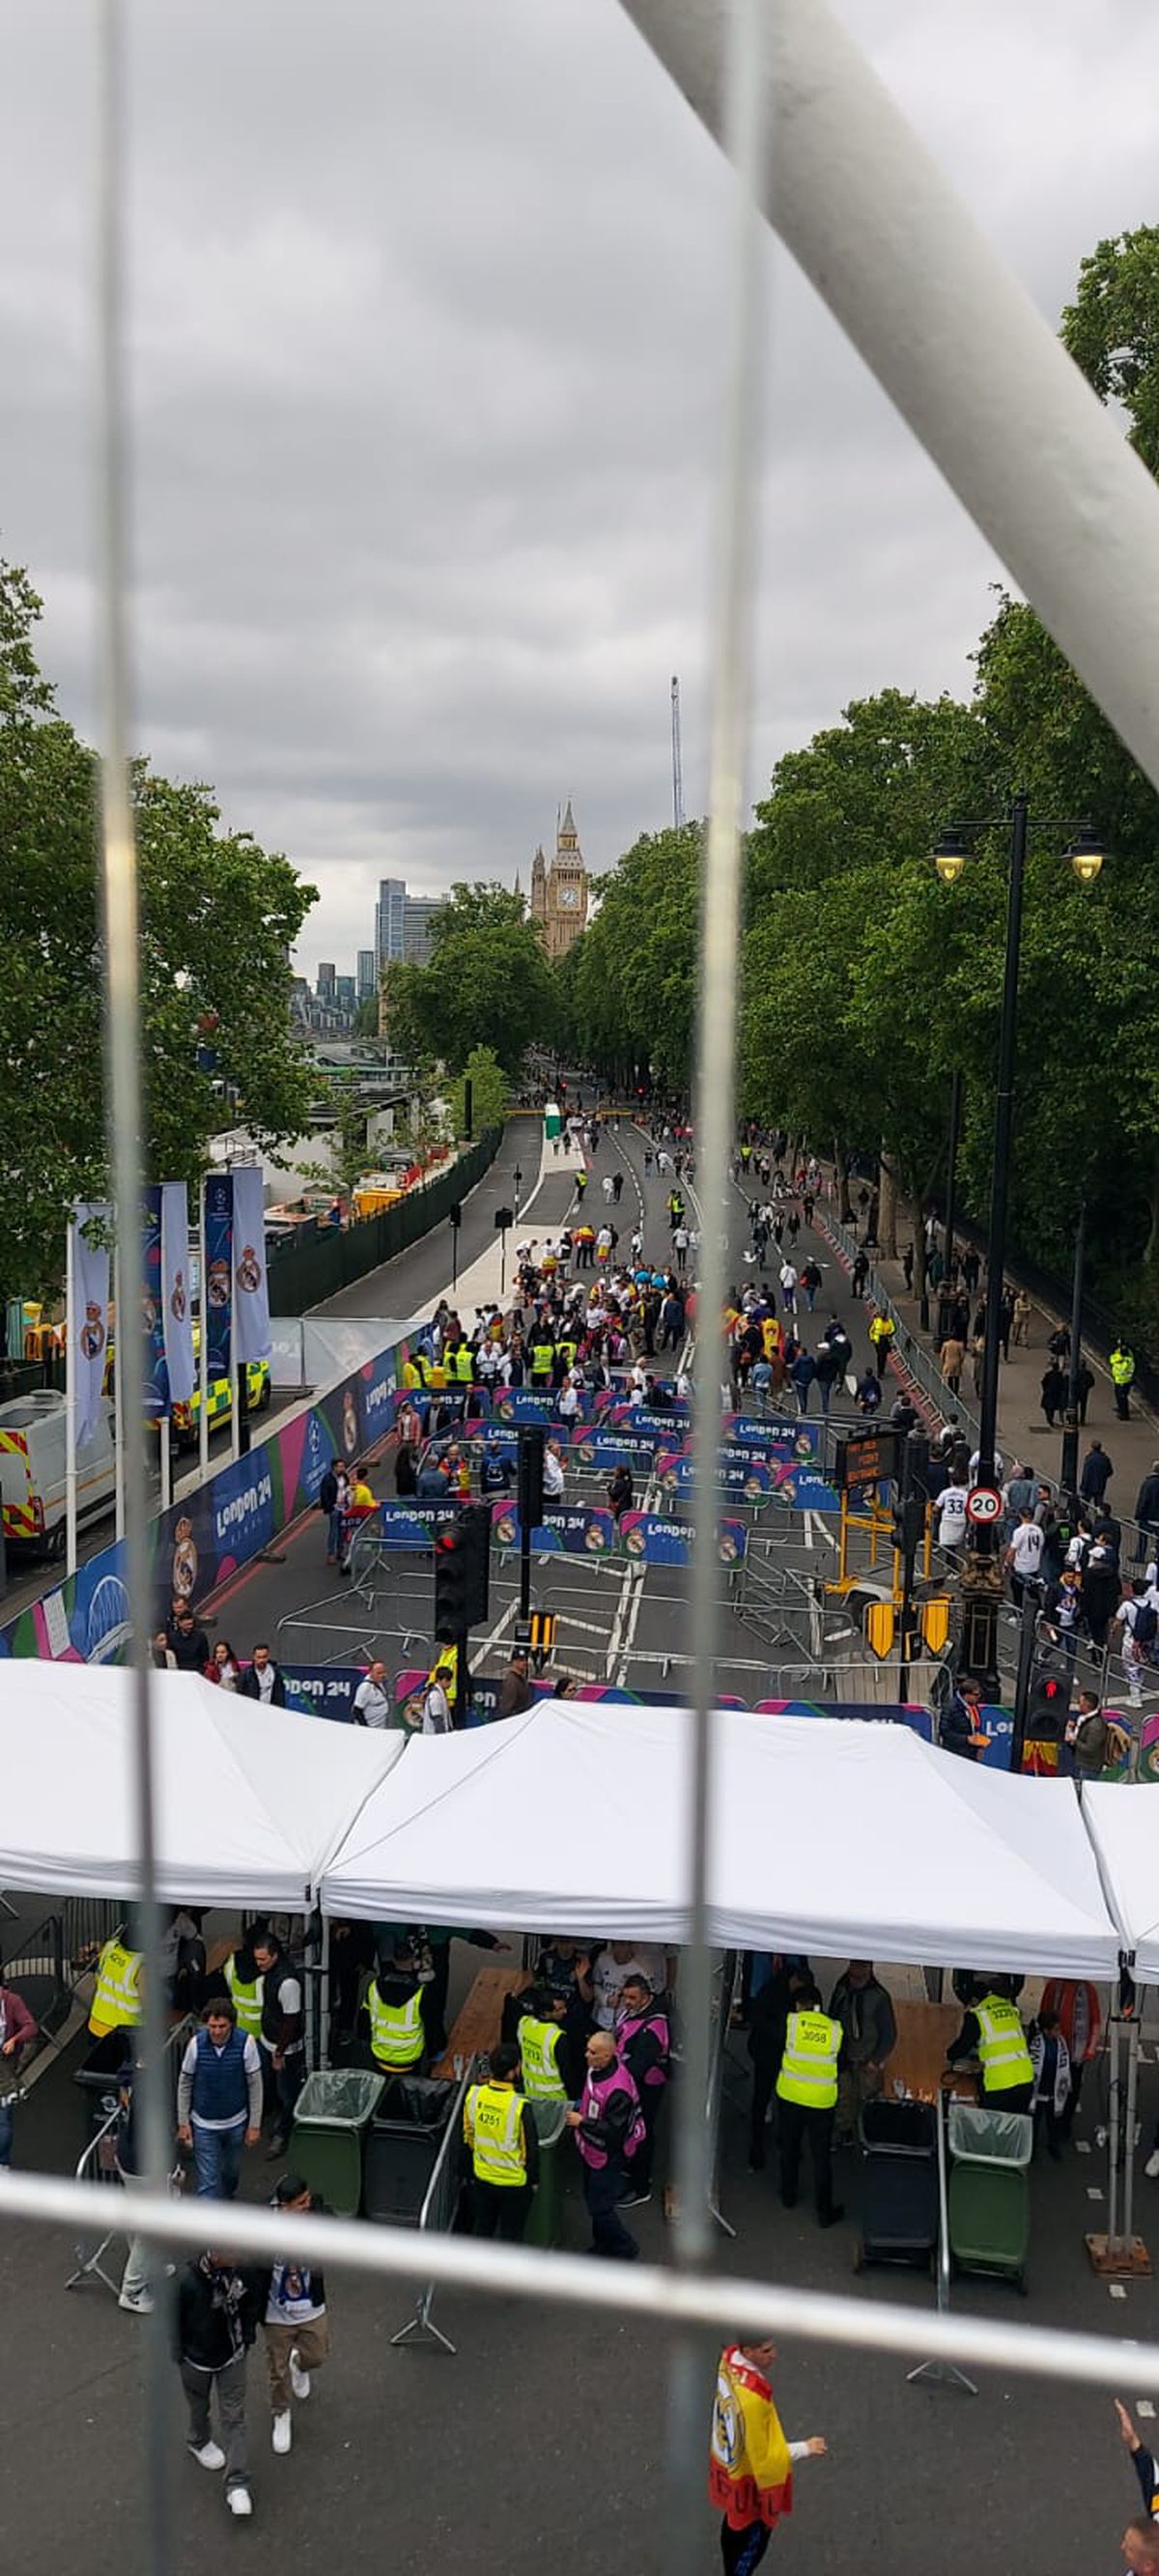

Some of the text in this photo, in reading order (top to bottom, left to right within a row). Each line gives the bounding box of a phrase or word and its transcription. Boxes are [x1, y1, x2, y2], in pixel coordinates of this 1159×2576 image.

[780, 1428, 796, 1438] 24
[639, 1439, 655, 1450] 24
[751, 1451, 766, 1461] 24
[728, 1469, 745, 1481] 24
[258, 1474, 271, 1506] 24
[947, 1498, 963, 1514] 33
[973, 1498, 996, 1513] 20
[567, 1517, 585, 1529] 24
[1028, 1535, 1040, 1552] 14
[326, 1681, 351, 1697] 24
[478, 2112, 500, 2126] 4251
